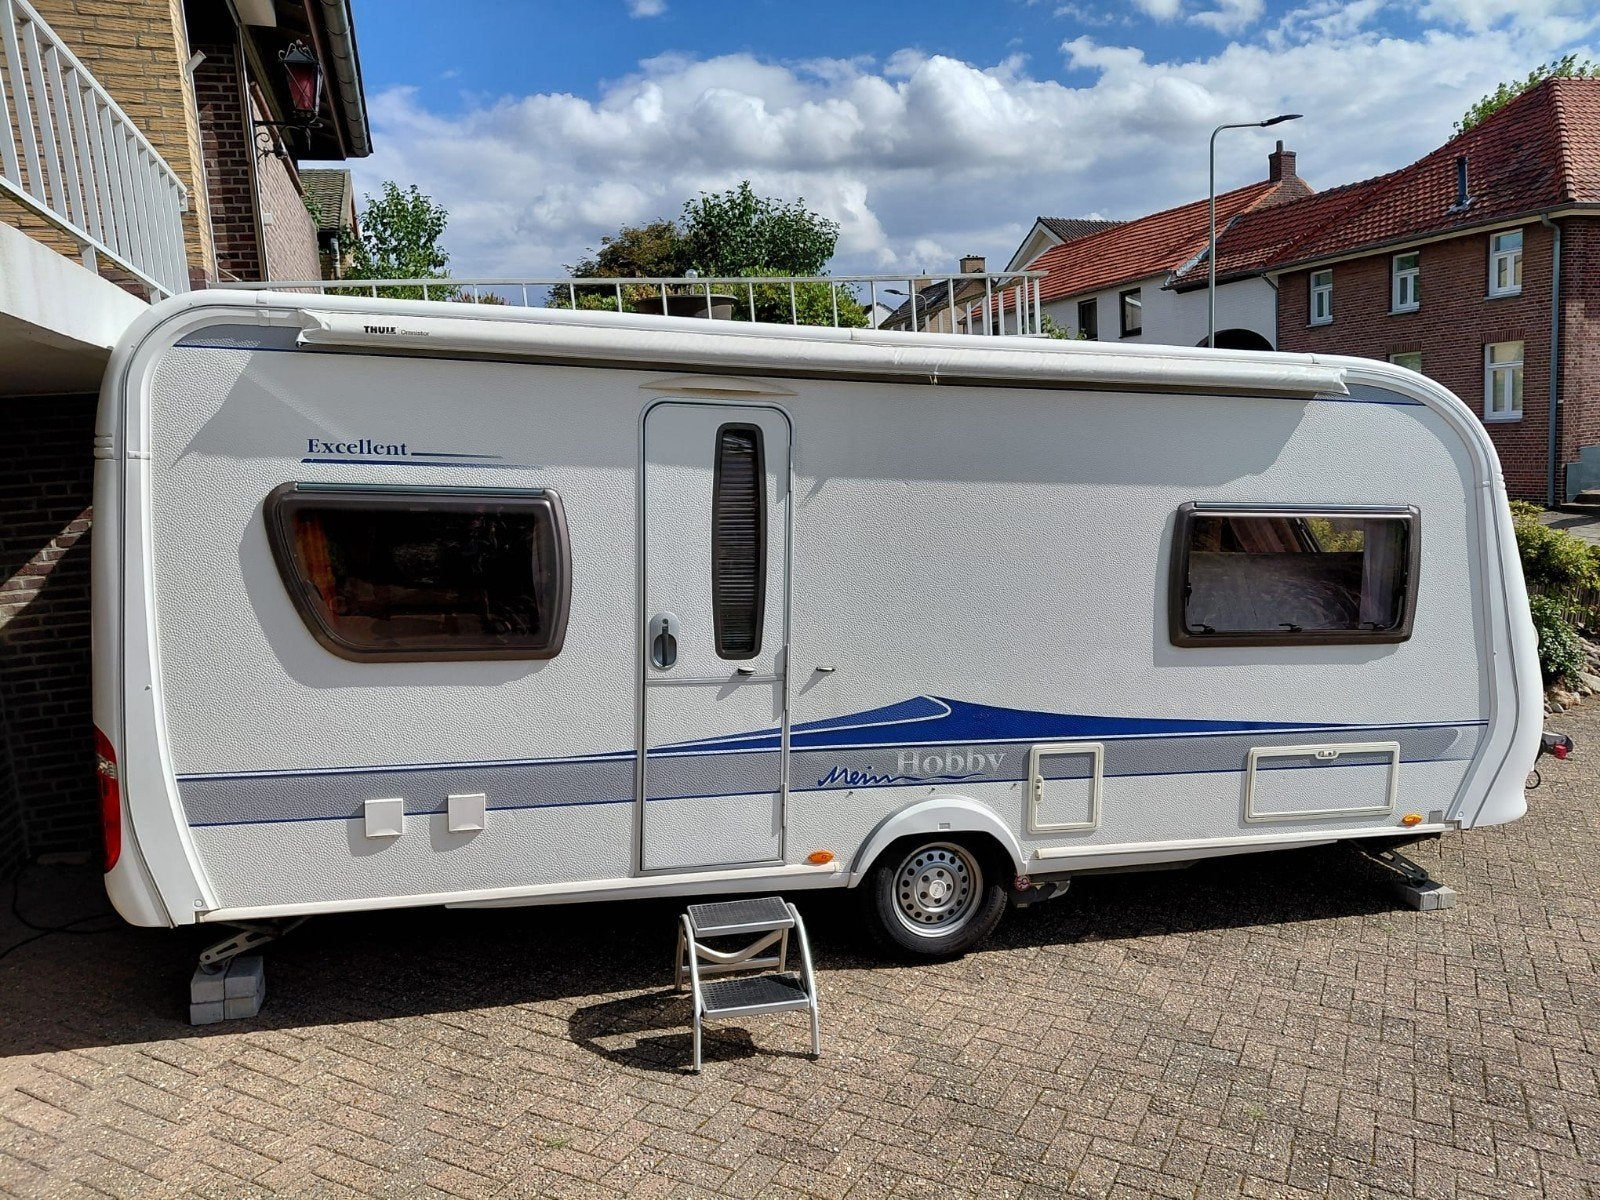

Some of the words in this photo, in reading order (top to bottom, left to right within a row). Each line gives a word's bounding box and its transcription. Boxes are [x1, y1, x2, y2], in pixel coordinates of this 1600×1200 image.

[364, 325, 397, 335] THULE
[307, 438, 408, 456] Excellent
[817, 766, 899, 787] Mein
[897, 748, 1007, 775] Hobby
